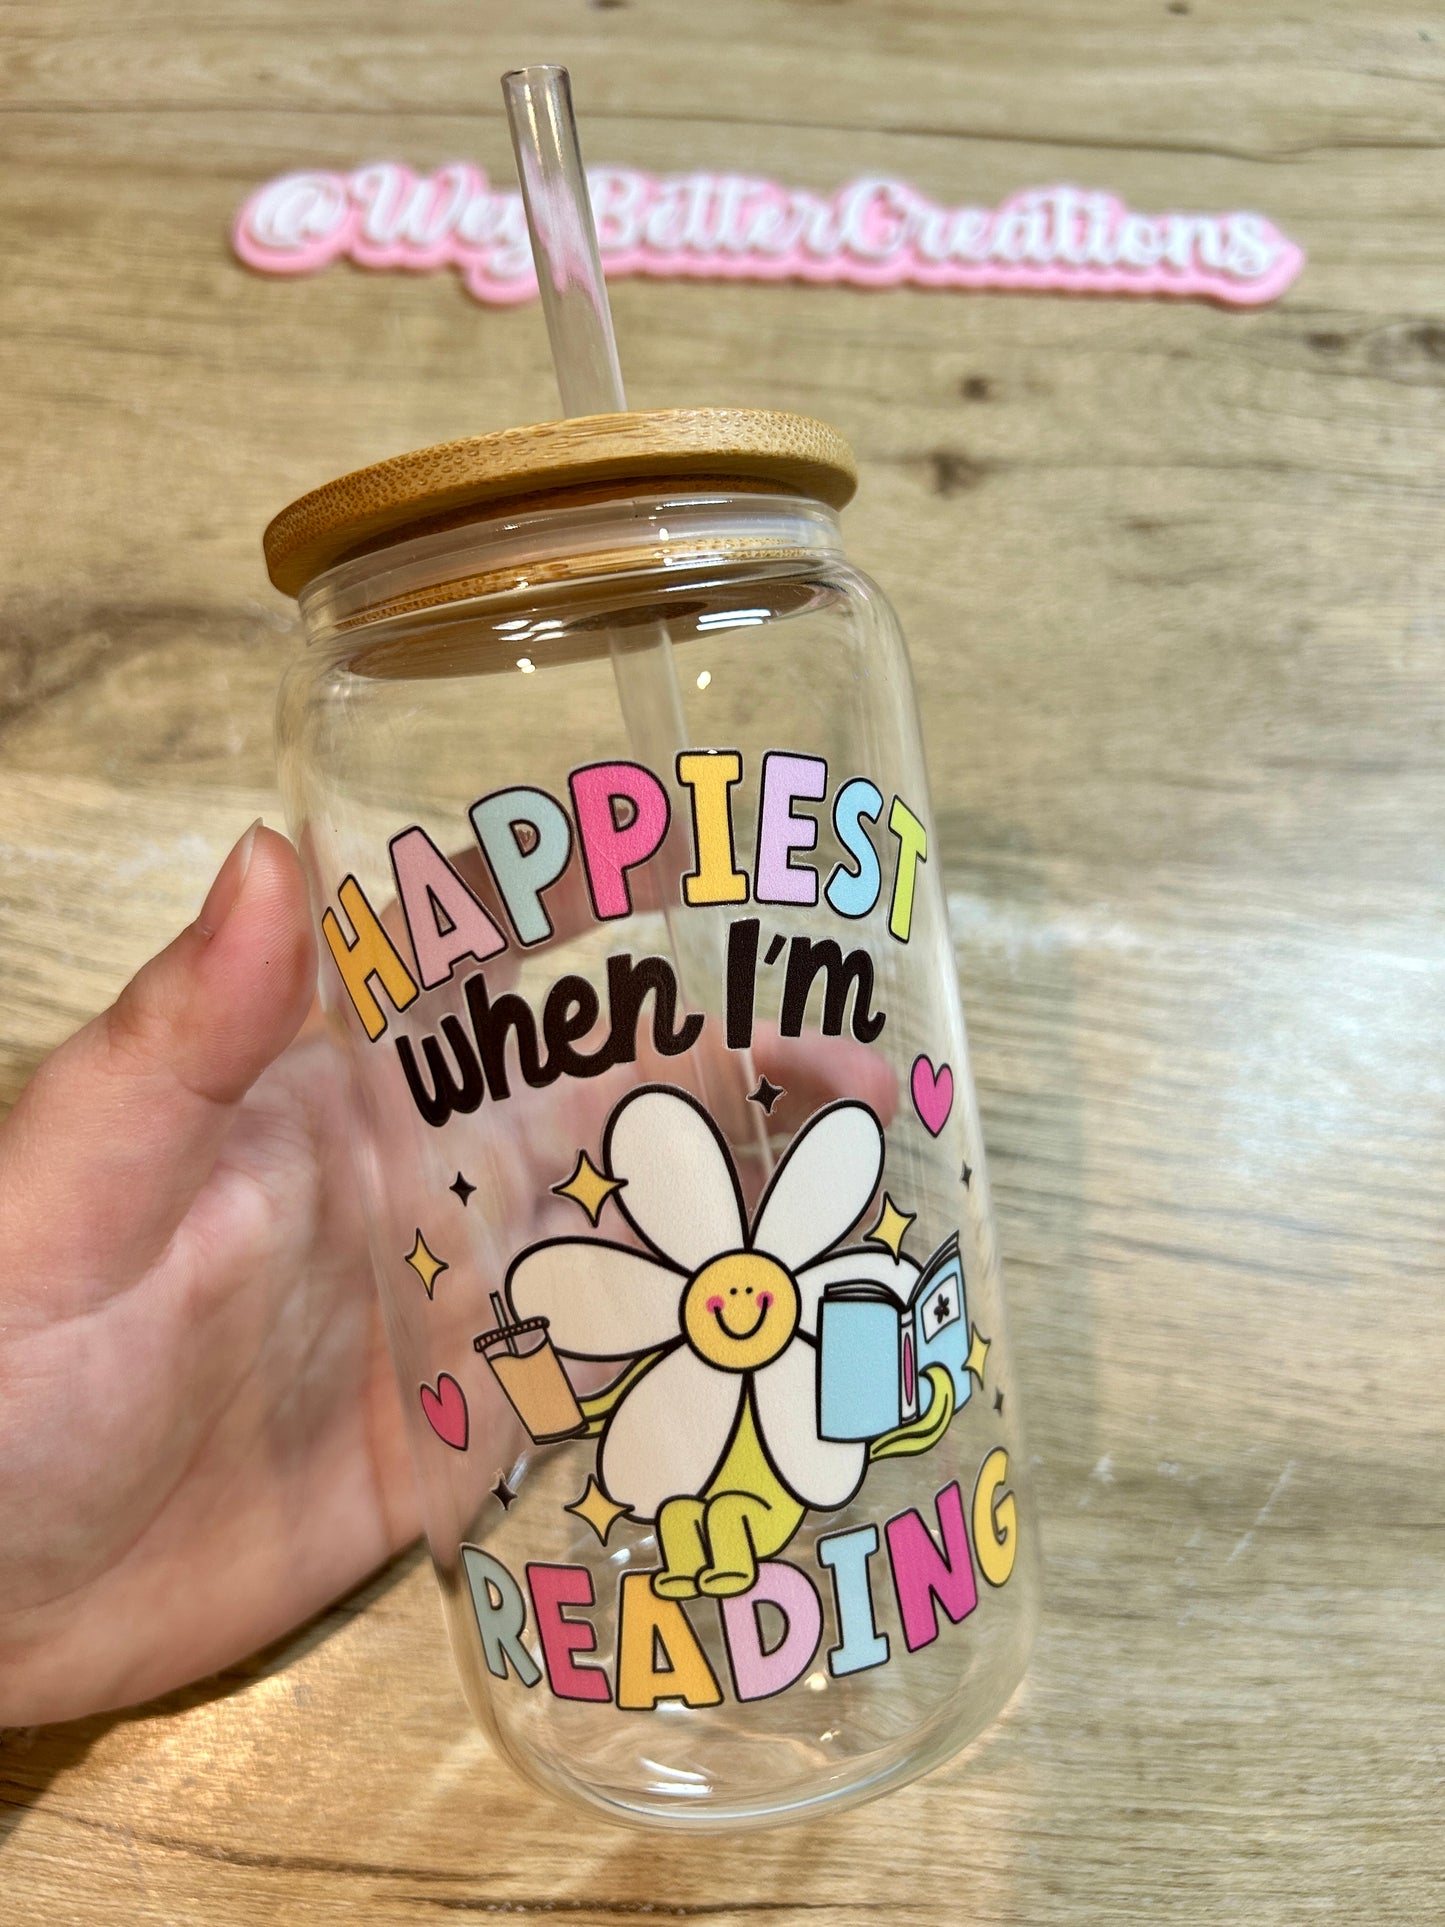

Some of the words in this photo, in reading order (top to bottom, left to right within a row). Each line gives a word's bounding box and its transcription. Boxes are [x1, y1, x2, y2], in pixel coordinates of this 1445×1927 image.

[322, 750, 928, 1043] HAPPIEST
[396, 952, 705, 1128] when
[724, 917, 887, 1050] I'm
[461, 1446, 1018, 1712] READING
